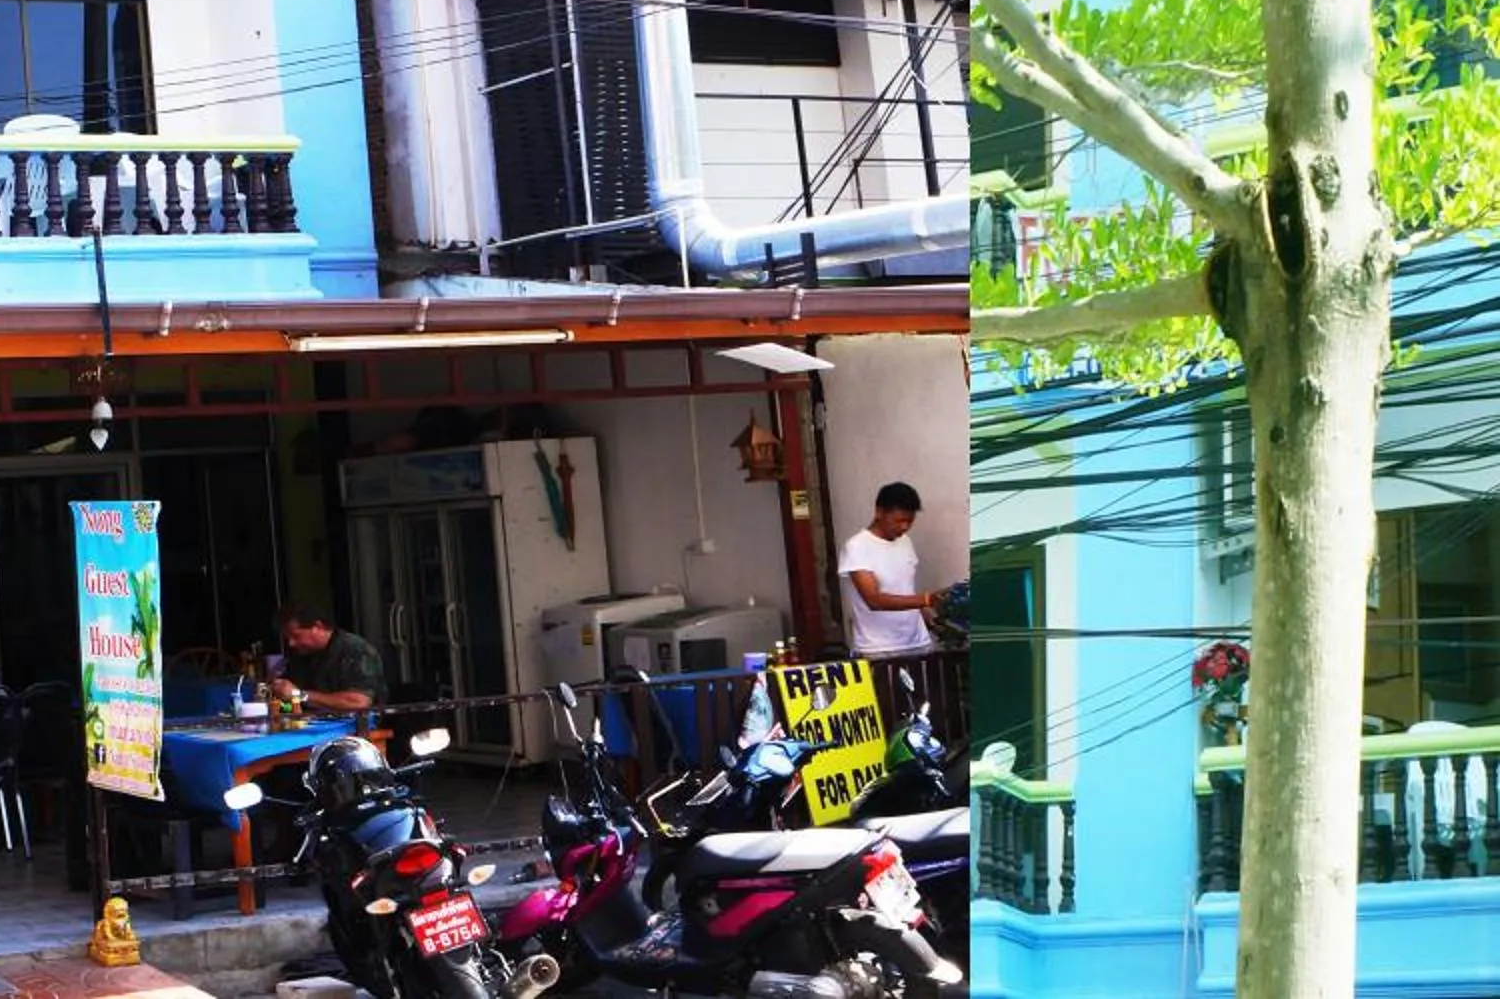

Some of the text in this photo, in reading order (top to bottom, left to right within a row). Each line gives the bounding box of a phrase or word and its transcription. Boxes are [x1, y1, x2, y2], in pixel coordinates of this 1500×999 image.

[84, 566, 129, 597] Guest
[89, 625, 142, 659] House
[828, 704, 881, 747] MONTH
[815, 773, 849, 809] FOR
